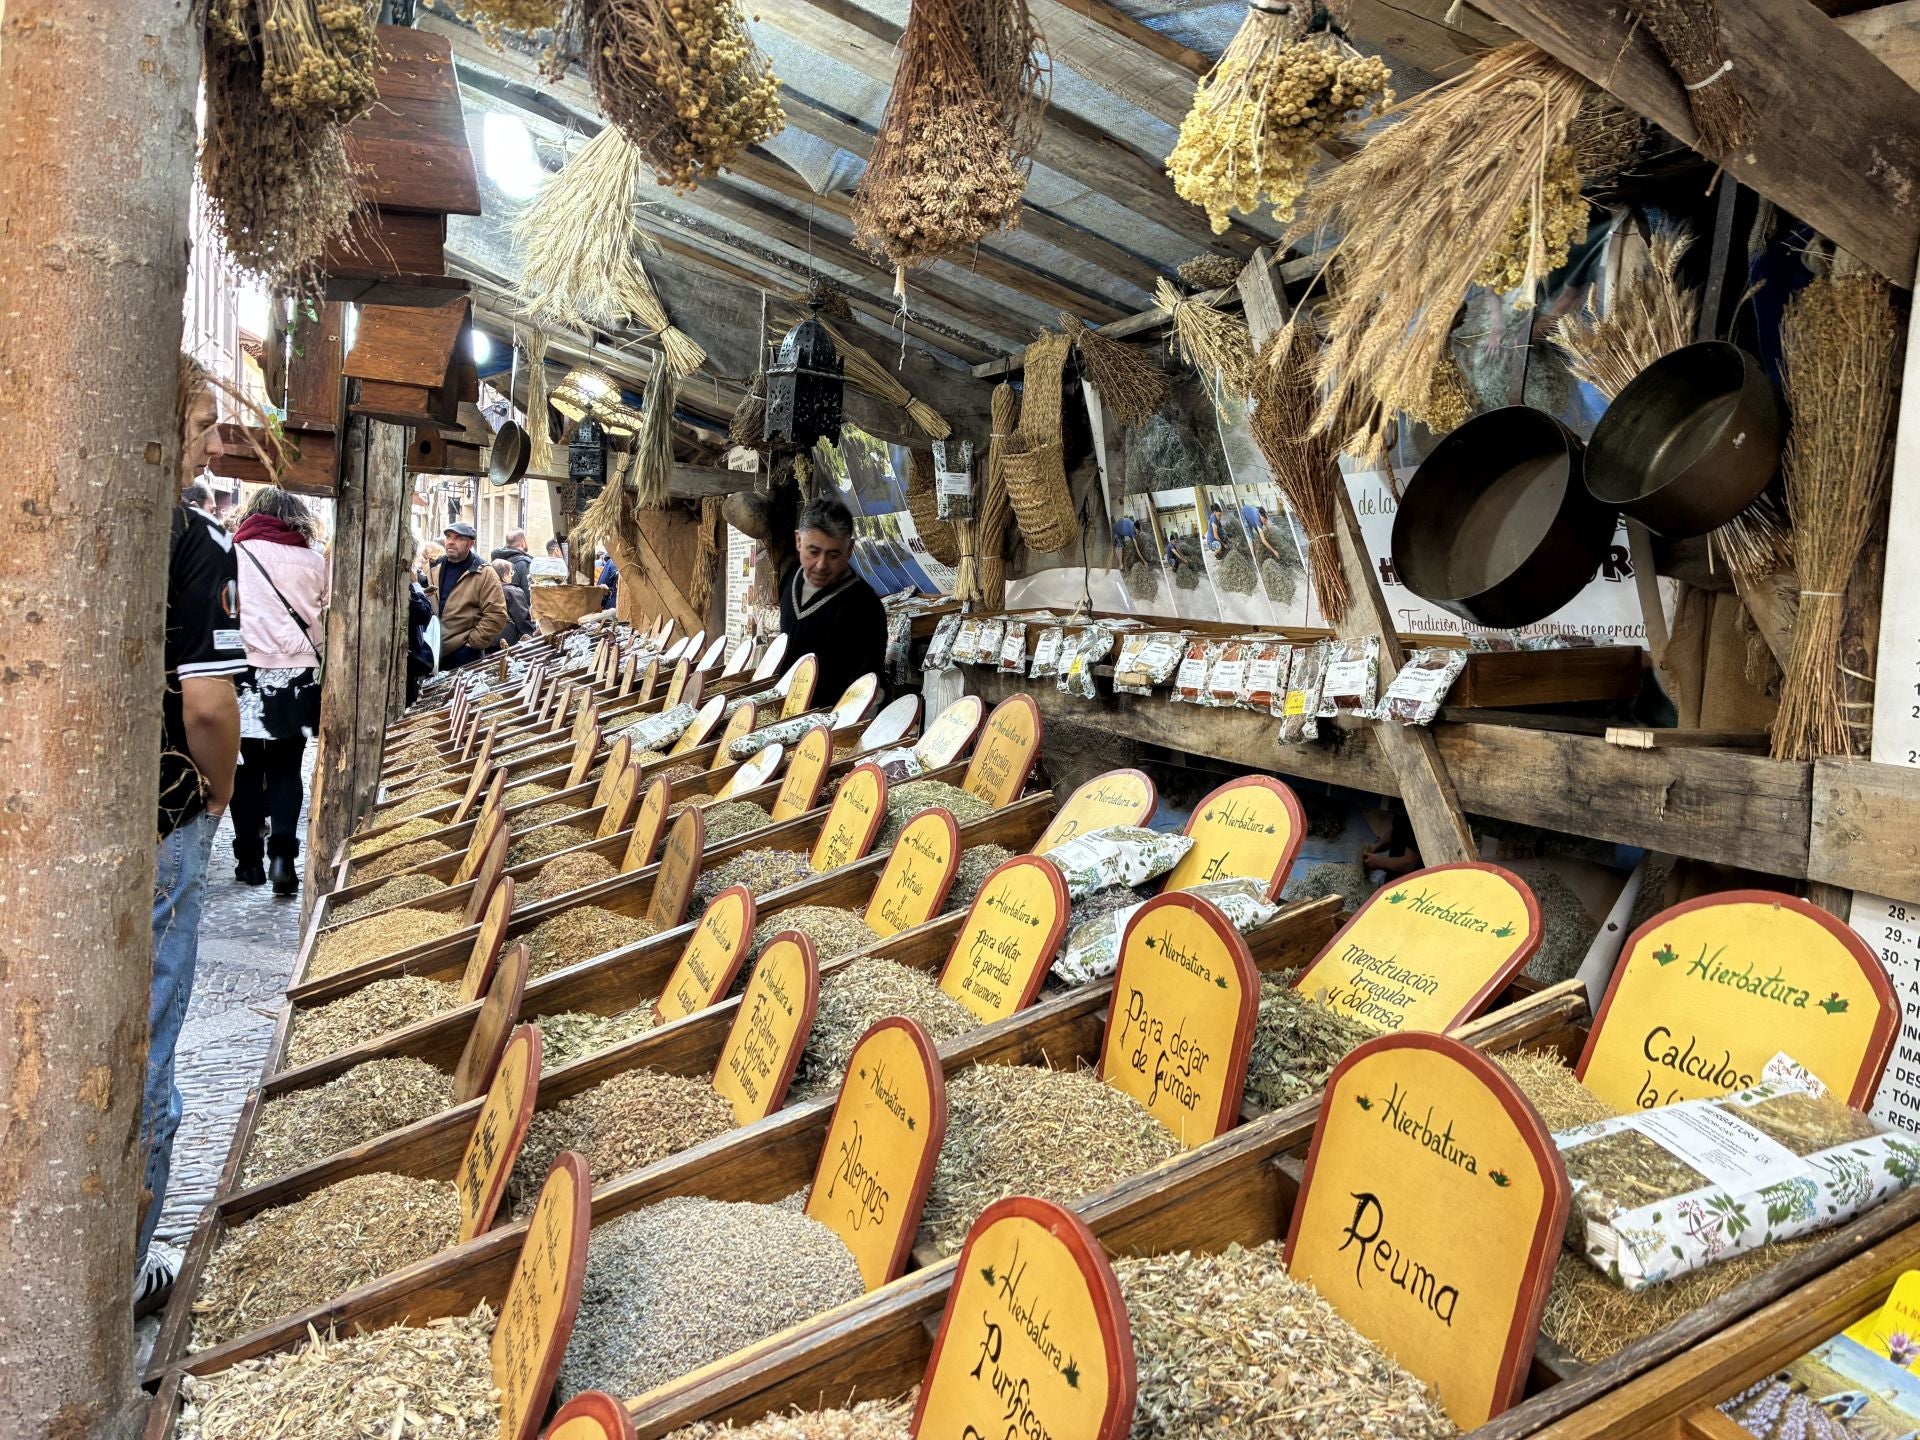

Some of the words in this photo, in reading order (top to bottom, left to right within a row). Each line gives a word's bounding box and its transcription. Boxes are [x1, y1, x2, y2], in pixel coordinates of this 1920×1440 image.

[1359, 489, 1376, 515] de
[1379, 488, 1396, 514] la
[1398, 609, 1458, 634] Tradición
[1534, 620, 1578, 636] varias
[1094, 785, 1130, 808] Hierbatura
[1218, 799, 1265, 834] Hierbatura
[912, 829, 936, 861] Hierbatura
[897, 895, 907, 911] y
[996, 884, 1031, 924] Hierbatura
[1407, 888, 1489, 933] Hierbatura
[1888, 904, 1915, 923] 28.-
[1884, 926, 1911, 945] 29.-
[973, 946, 984, 969] la
[1157, 929, 1211, 983] Hierbatura
[1686, 942, 1811, 1009] Hierbatura
[1882, 948, 1908, 967] 30.-
[764, 956, 789, 1010] Hierbatura
[962, 968, 973, 991] de
[972, 981, 1002, 1009] memoria
[1341, 988, 1405, 1030] dolorosa
[1119, 984, 1164, 1050] Para
[1170, 1016, 1210, 1078] dejar
[1903, 1023, 1920, 1041] IN
[1131, 1034, 1148, 1074] de
[1643, 1025, 1755, 1092] Calculos
[870, 1058, 906, 1122] Hierbatura
[1636, 1069, 1659, 1110] la
[1378, 1082, 1478, 1175] Hierbatura
[1338, 1191, 1460, 1328] Reuma
[998, 1236, 1063, 1372] Hierbatura
